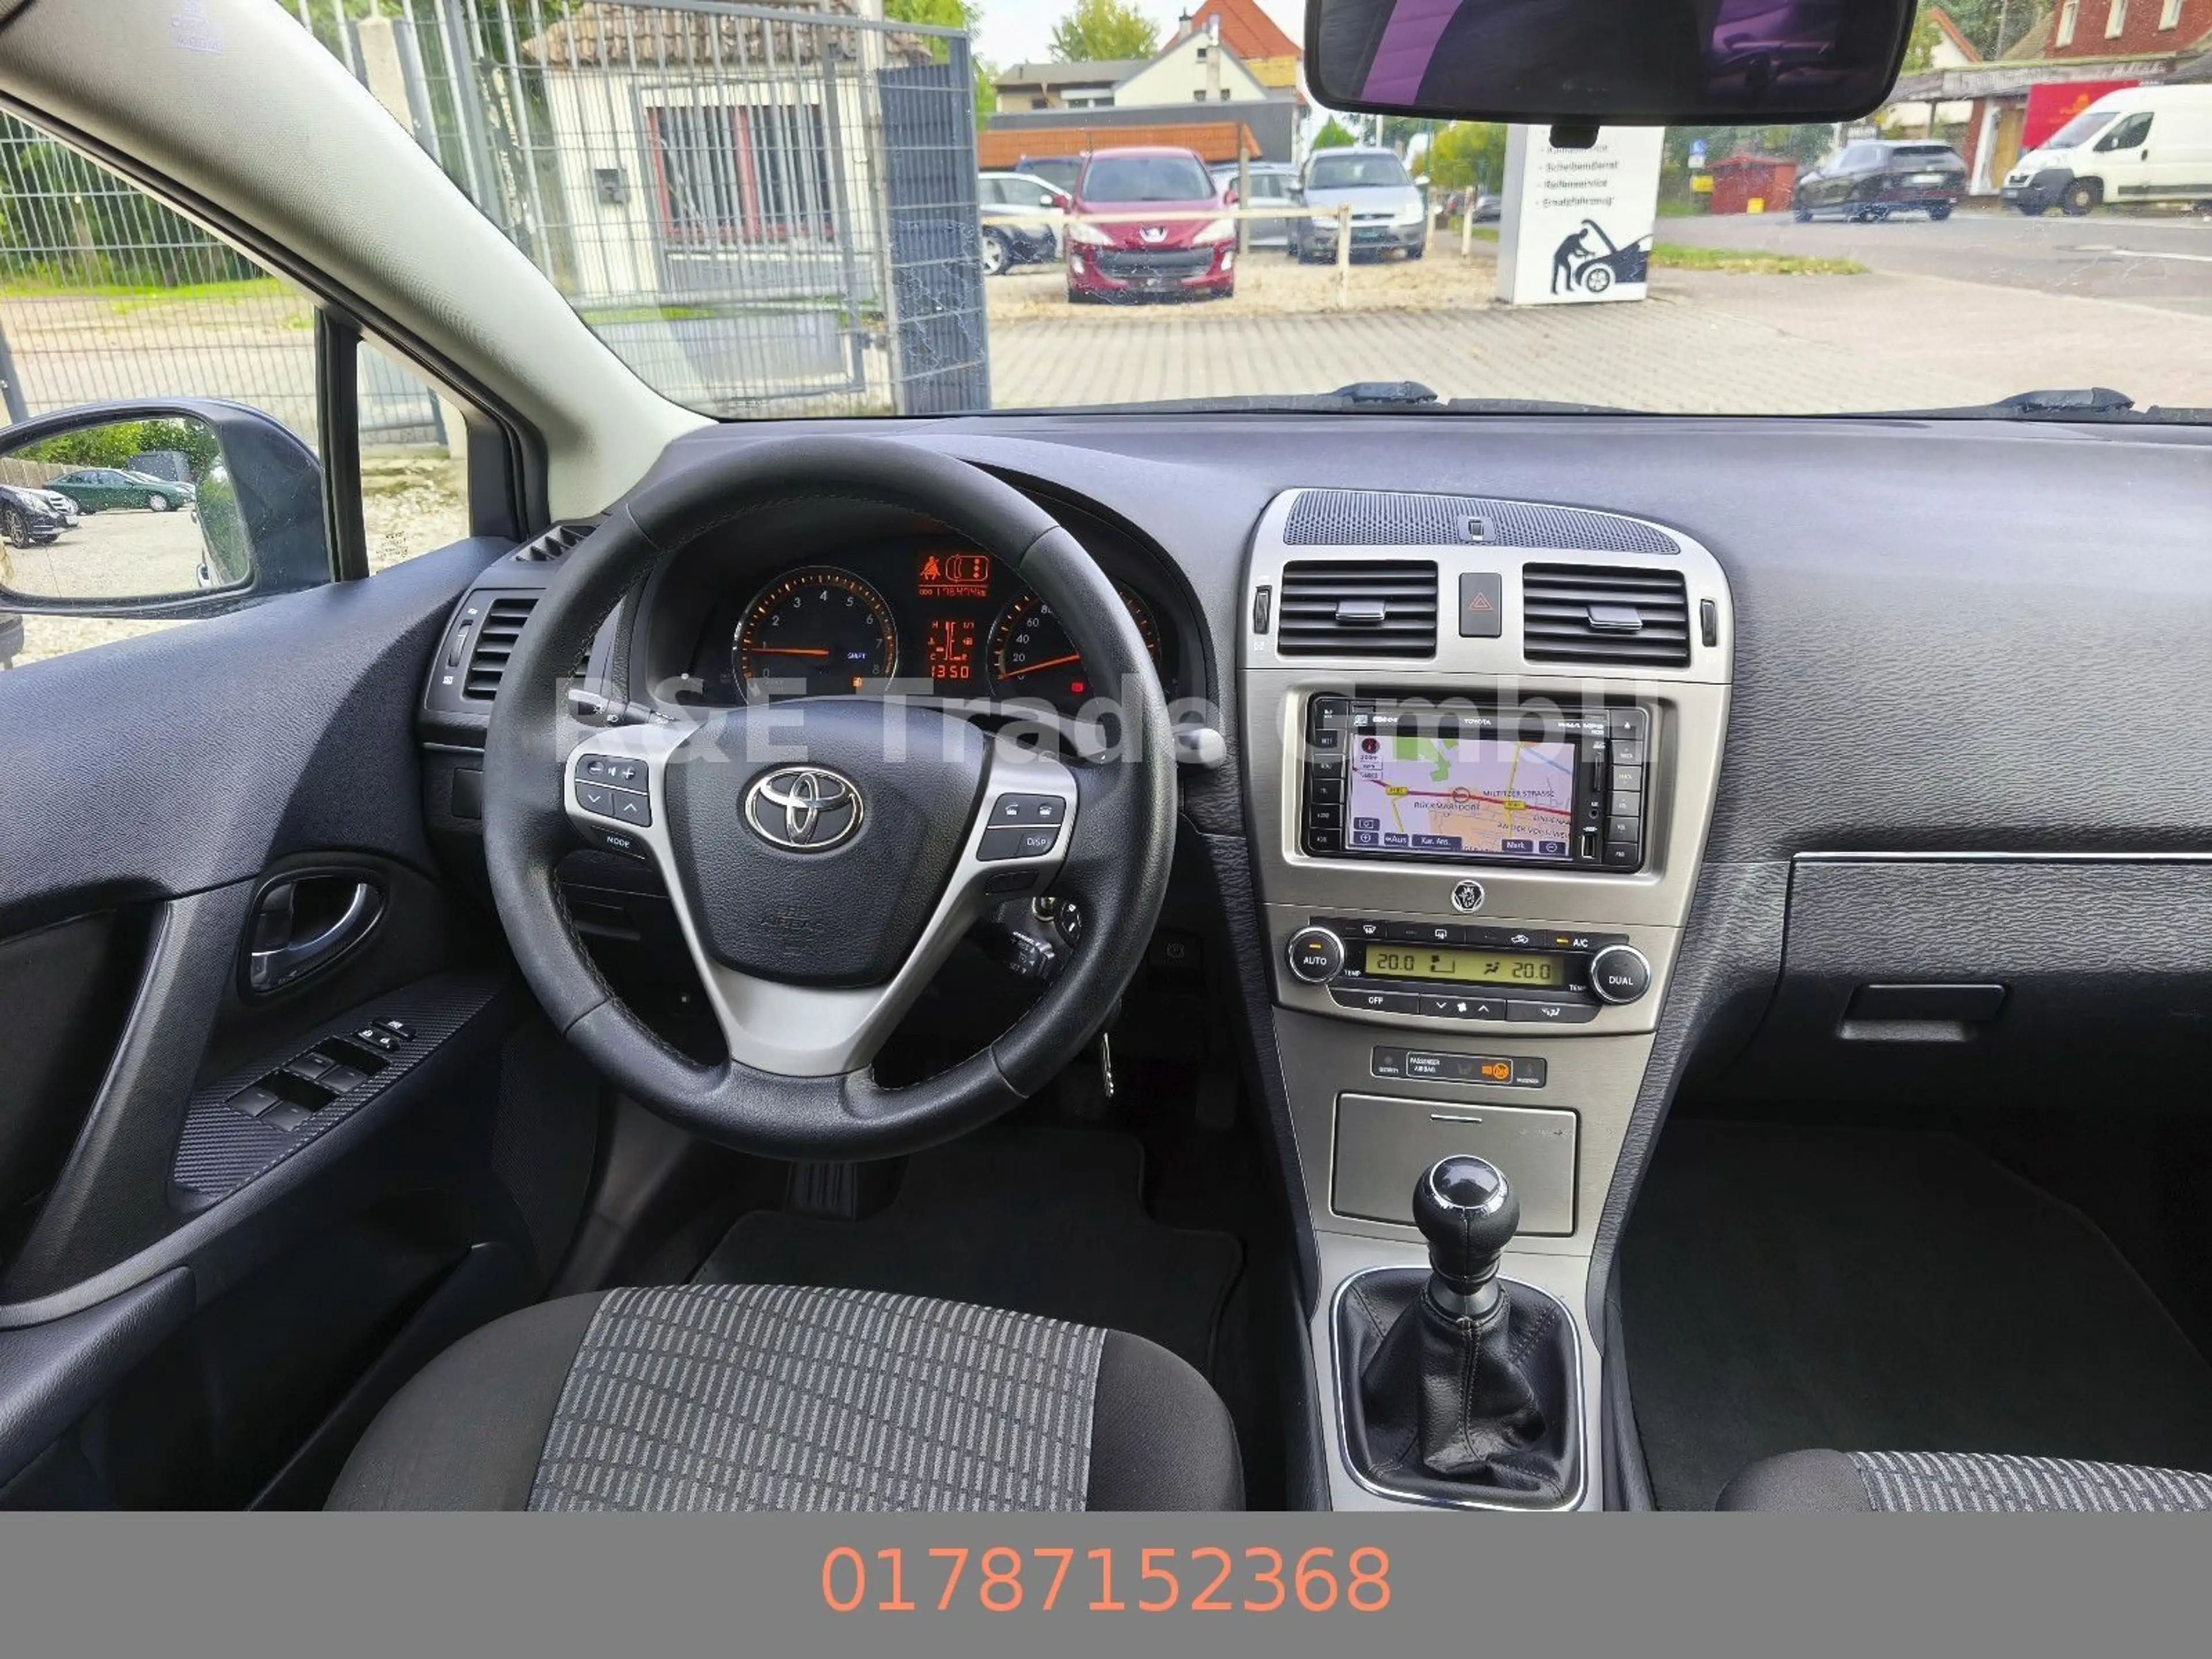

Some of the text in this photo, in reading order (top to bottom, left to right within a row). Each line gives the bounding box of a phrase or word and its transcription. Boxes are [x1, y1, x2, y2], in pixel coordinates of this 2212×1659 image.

[819, 590, 828, 601] 4
[794, 597, 801, 608] 3
[846, 597, 854, 607] 5
[772, 615, 779, 626] 2
[866, 614, 873, 624] 6
[1027, 618, 1039, 627] 60
[1016, 635, 1029, 644] 40
[1013, 653, 1025, 662] 20
[607, 836, 630, 849] MODE
[1027, 838, 1047, 847] DISP
[1573, 938, 1588, 948] A/C
[1304, 956, 1327, 965] AUTO
[1377, 954, 1415, 971] 20.0
[1512, 962, 1551, 979] 20.0
[1608, 976, 1634, 986] DUAL
[1368, 996, 1384, 1005] OFF
